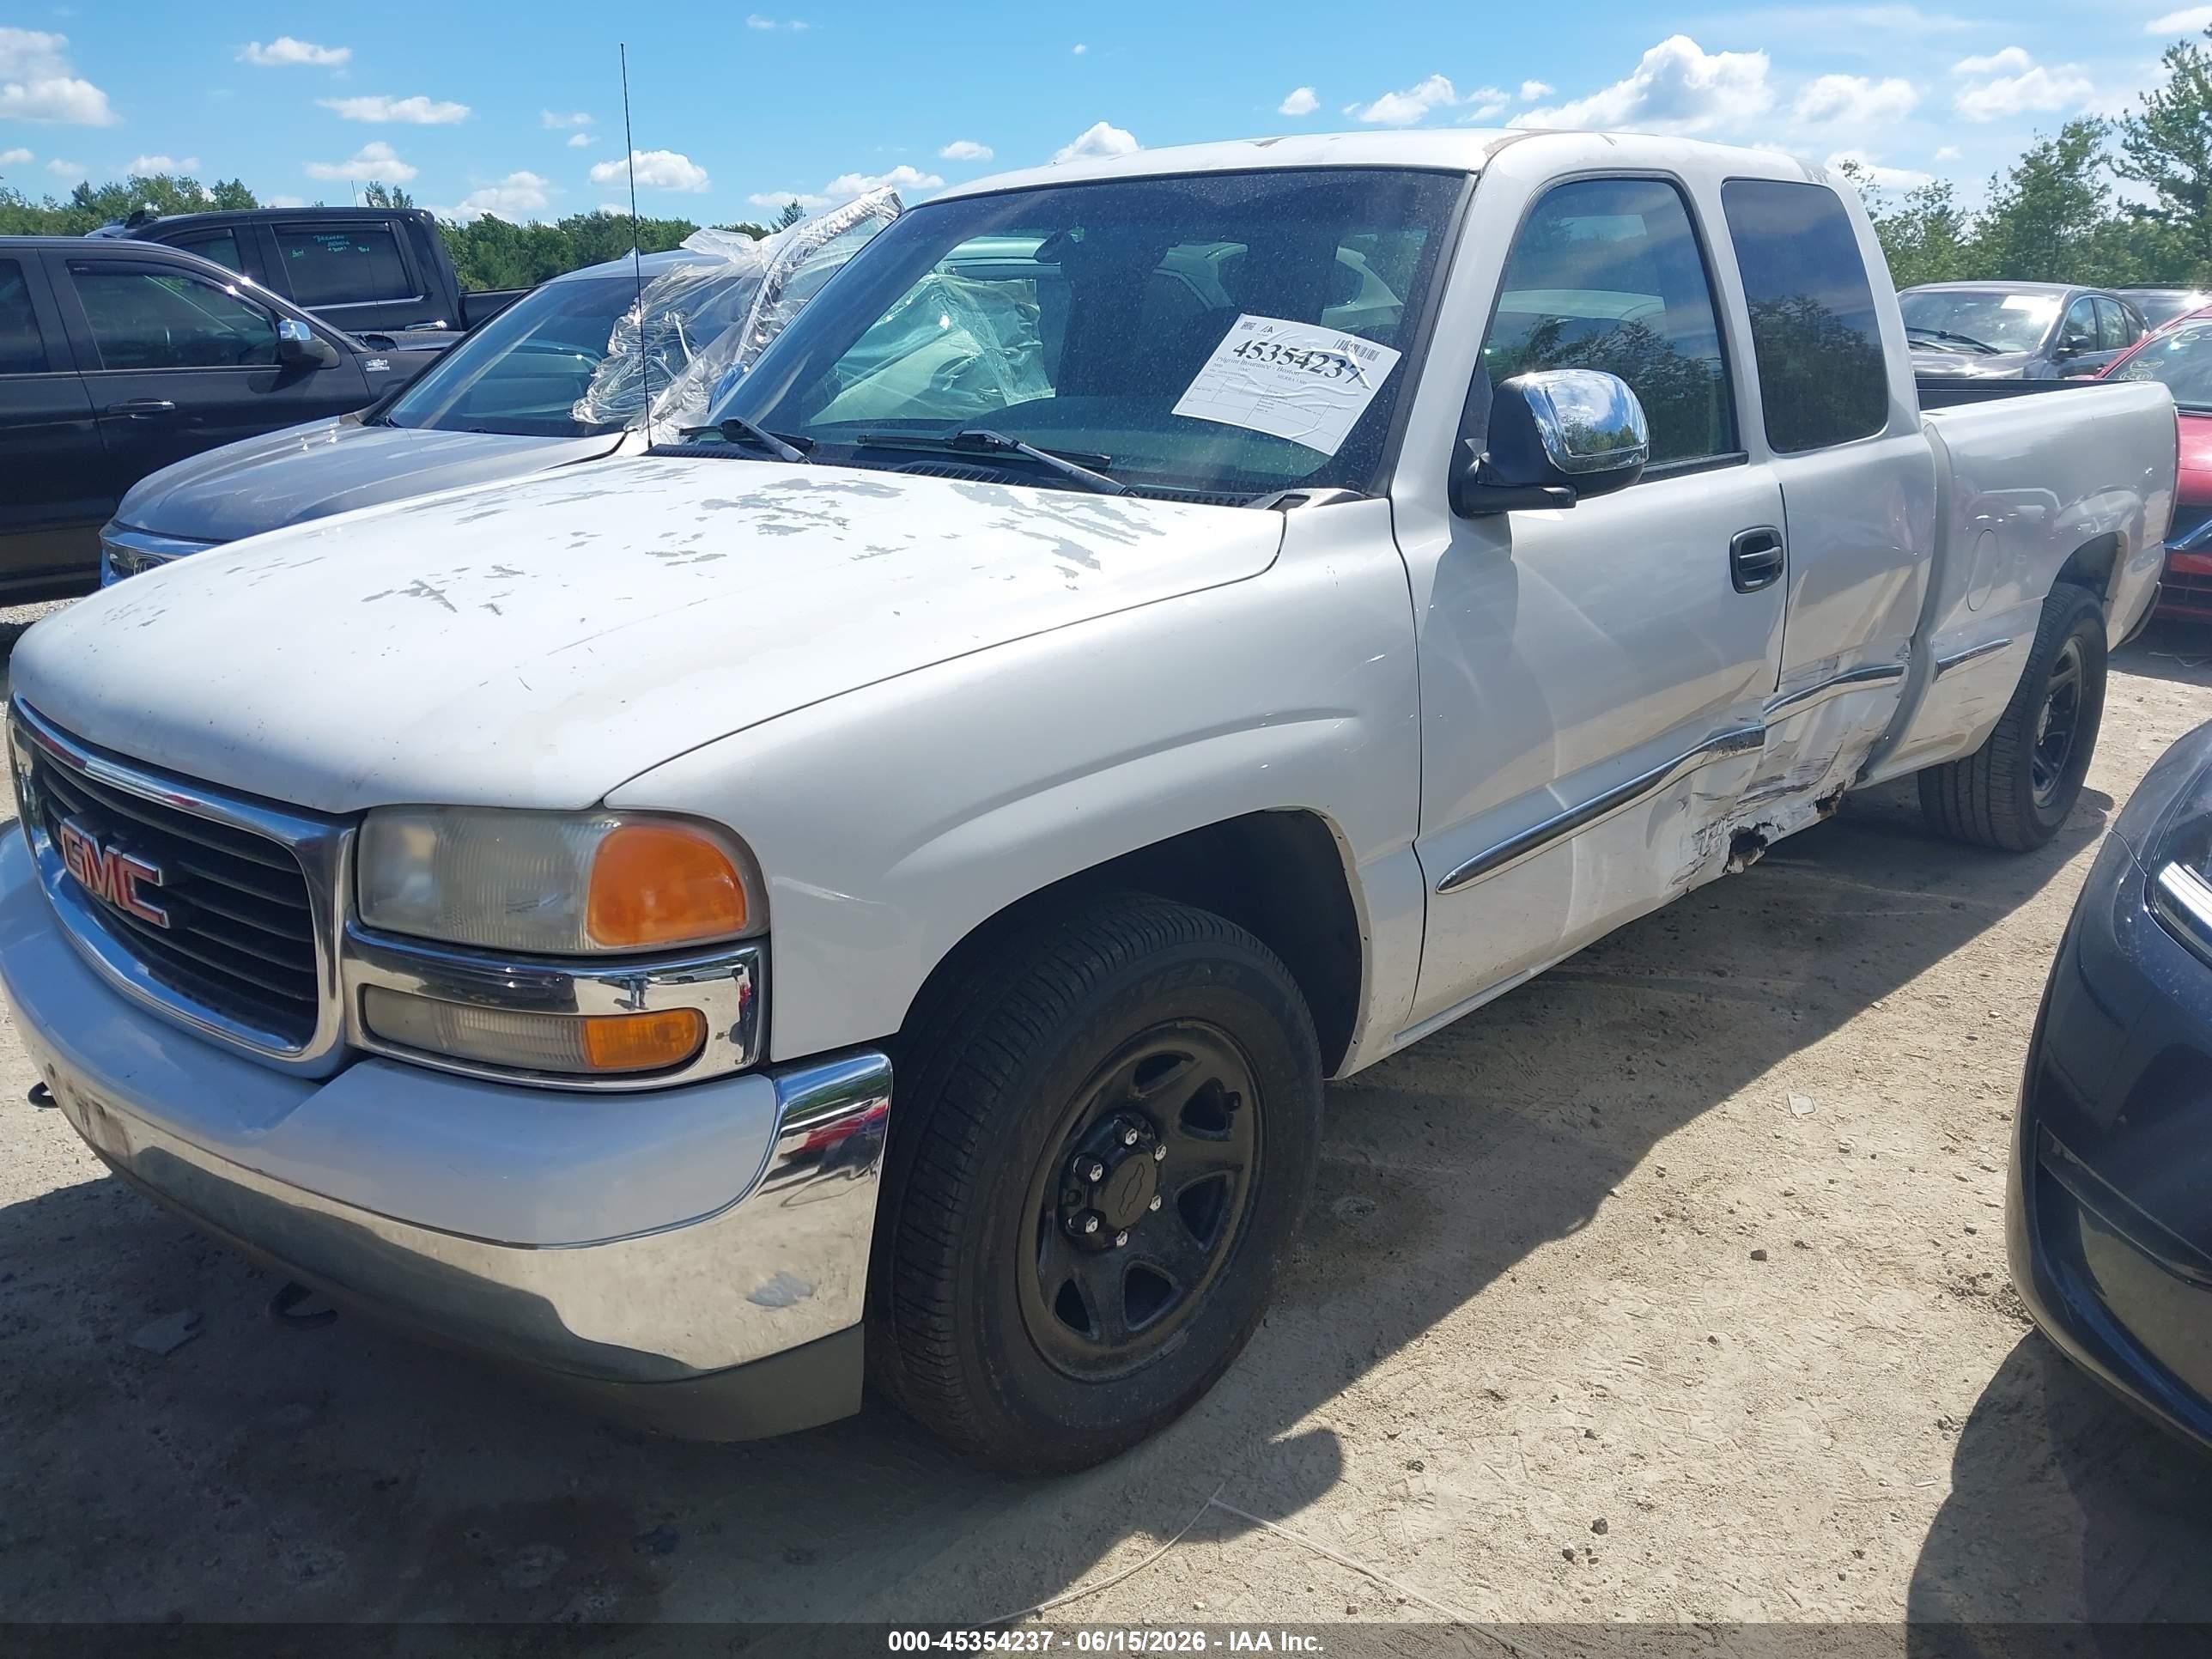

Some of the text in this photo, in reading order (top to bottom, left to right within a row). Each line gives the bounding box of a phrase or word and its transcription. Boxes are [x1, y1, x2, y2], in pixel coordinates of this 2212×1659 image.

[1216, 356, 1240, 365] Pilgrim
[1240, 358, 1272, 369] Insurance
[1276, 365, 1300, 376] Boston
[1233, 338, 1366, 385] 45354237
[60, 817, 170, 929] GMC
